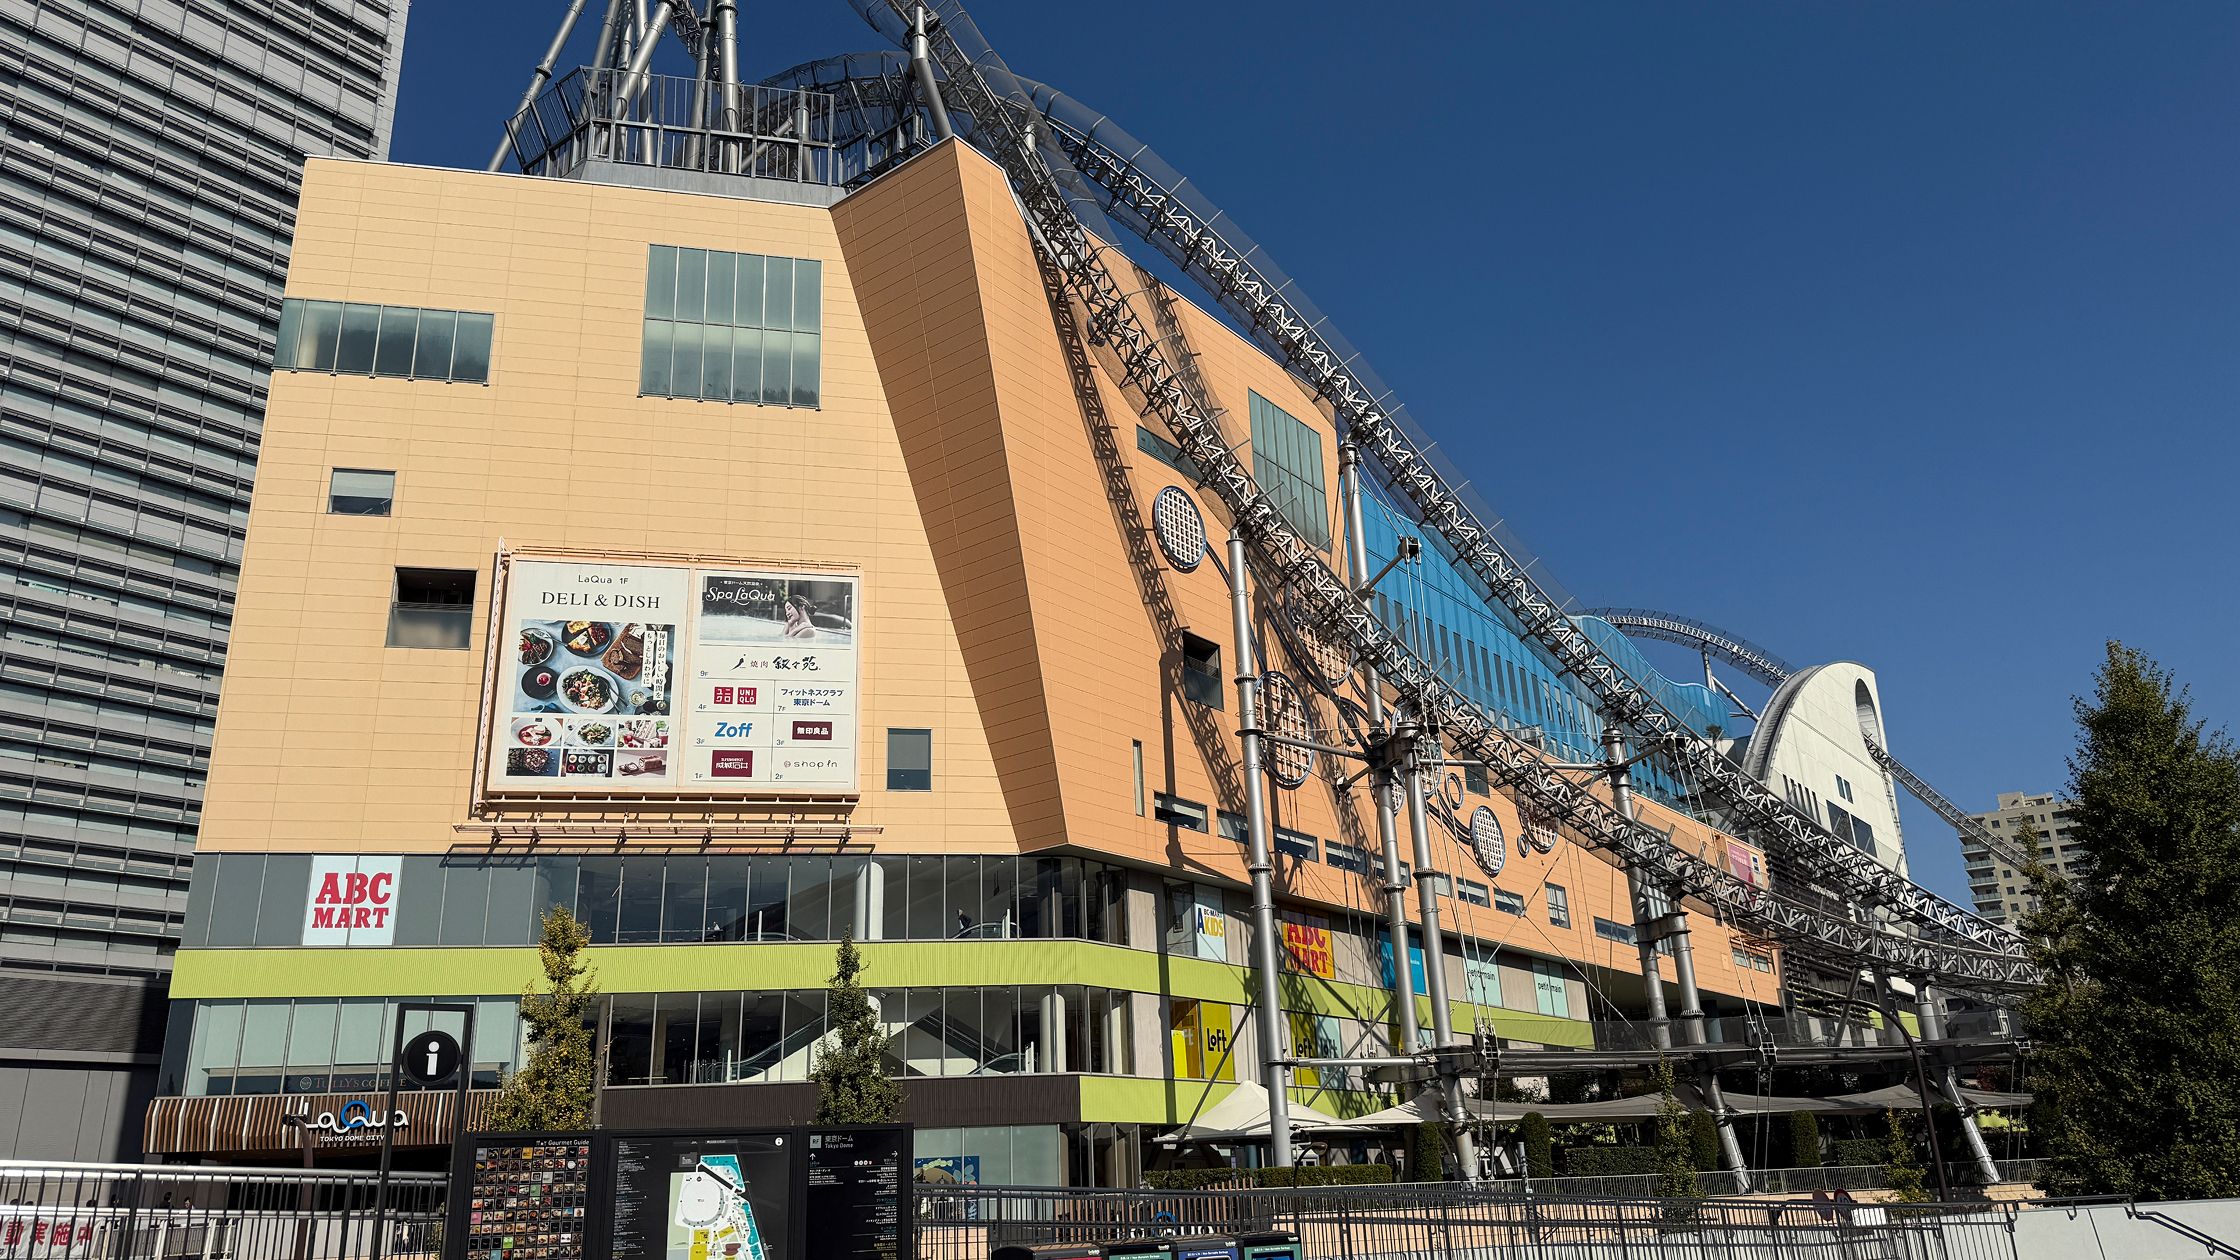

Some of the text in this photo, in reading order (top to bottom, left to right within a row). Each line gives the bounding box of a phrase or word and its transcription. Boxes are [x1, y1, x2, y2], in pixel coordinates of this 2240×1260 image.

[578, 574, 629, 585] LaQua 1F
[541, 591, 661, 609] DELI & DISH
[706, 587, 775, 606] Spa LaQua
[643, 632, 653, 685] もっとしあわせに
[655, 632, 666, 699] 毎日のおいしい時間を
[716, 688, 731, 696] ユニ
[781, 689, 844, 697] フィットネスクラブ
[739, 696, 755, 704] QLO
[793, 698, 831, 706] 東京ドーム
[714, 722, 753, 738] Zoff
[797, 726, 829, 735] 無印良品
[794, 760, 824, 770] shop
[315, 872, 392, 905] ABC
[312, 907, 389, 929] MART
[361, 1077, 407, 1088] COFE
[304, 1100, 409, 1134] LaQua
[825, 1135, 854, 1143] 東京ドーム
[0, 1221, 93, 1247] 動実施中
